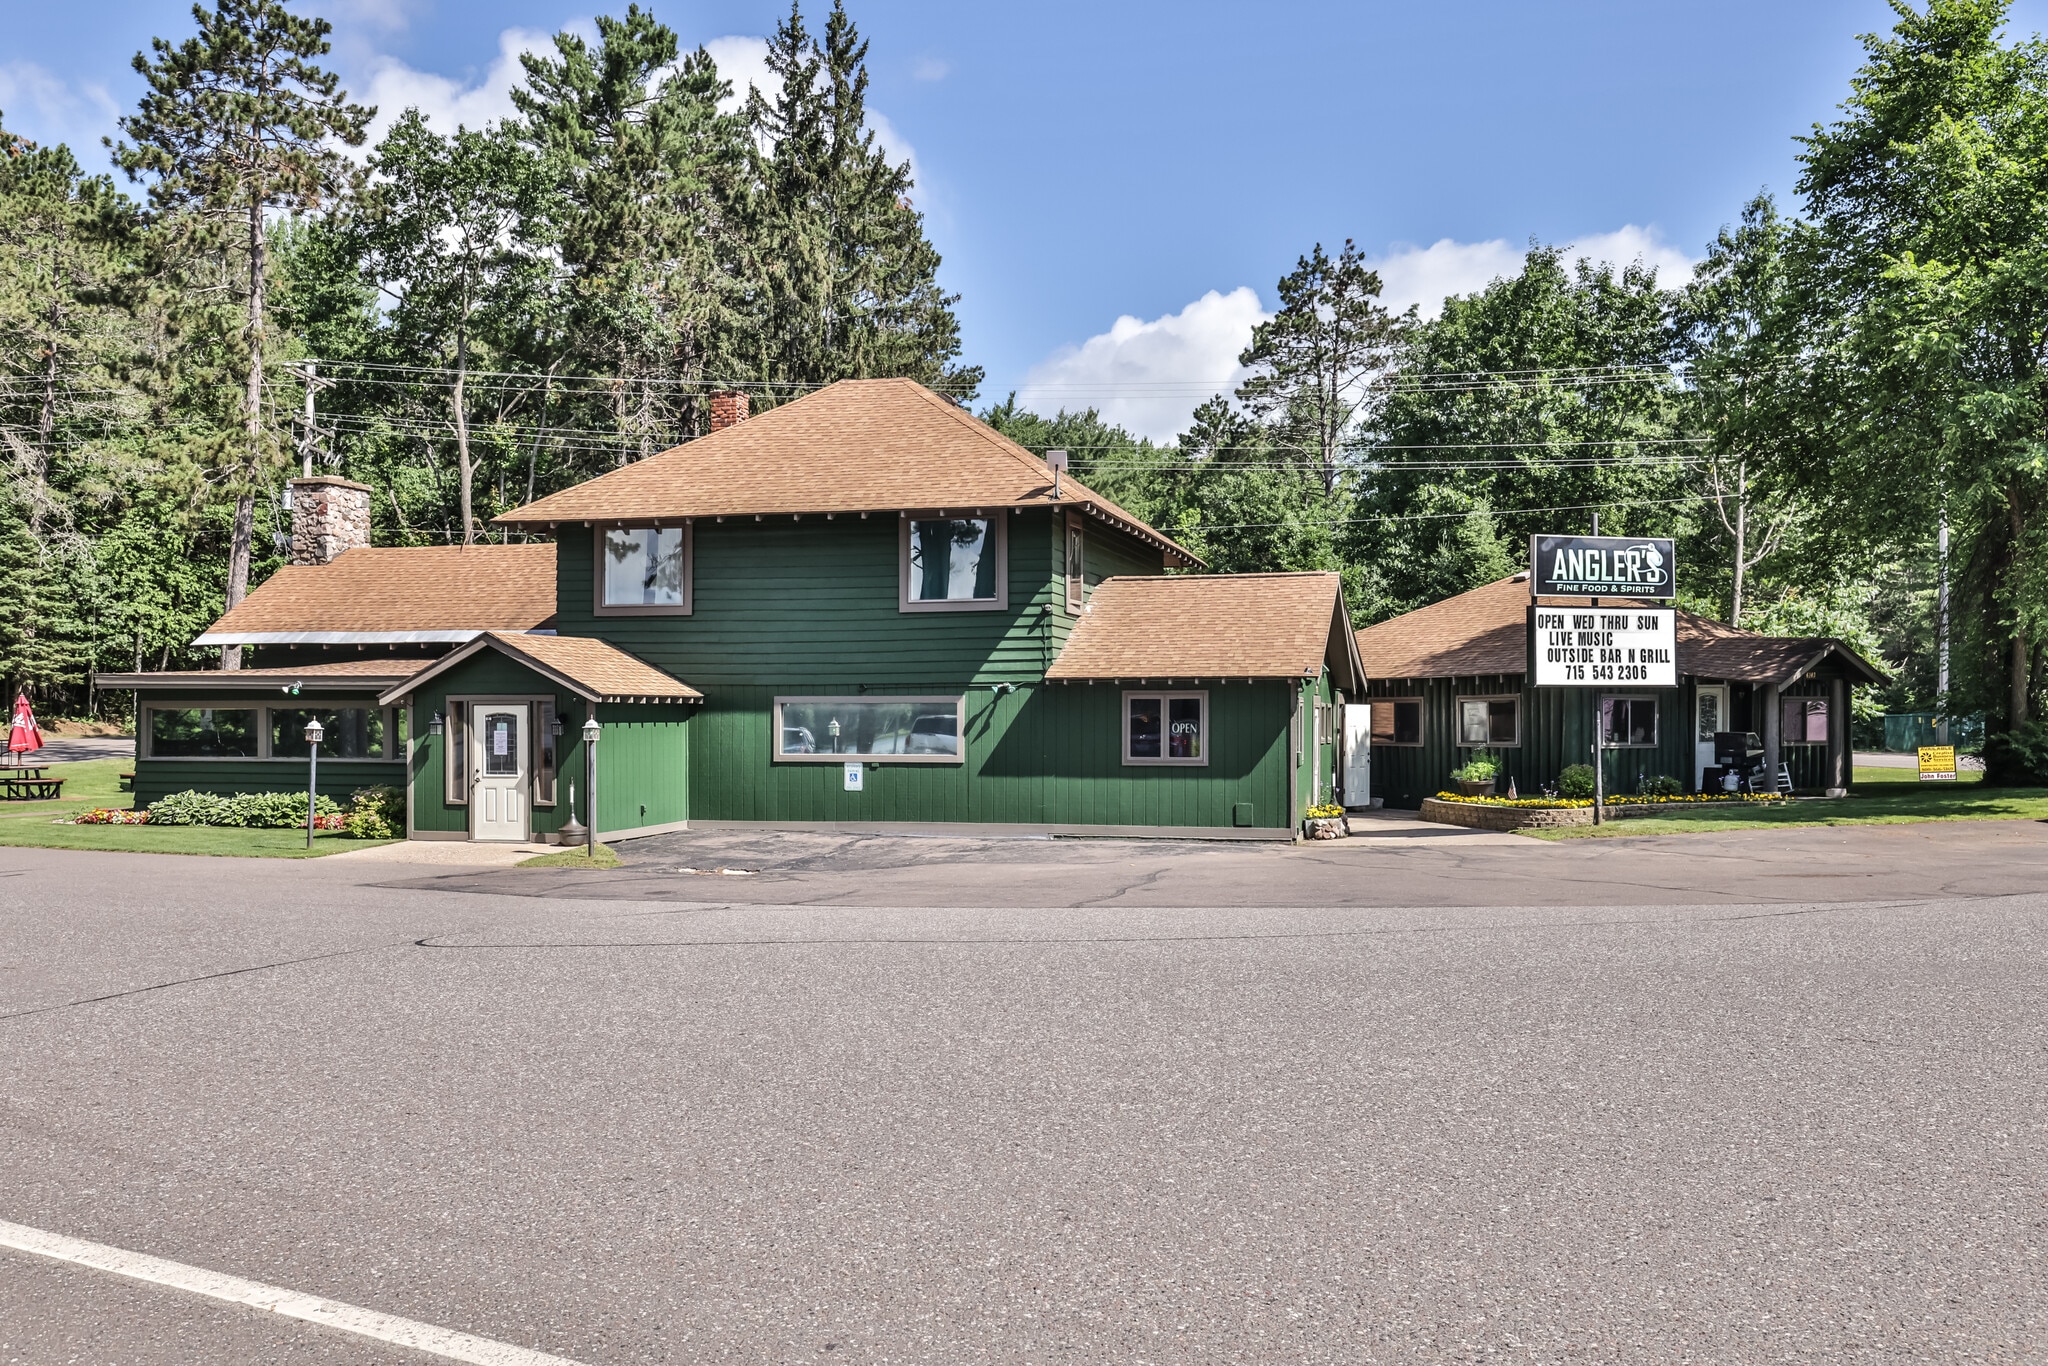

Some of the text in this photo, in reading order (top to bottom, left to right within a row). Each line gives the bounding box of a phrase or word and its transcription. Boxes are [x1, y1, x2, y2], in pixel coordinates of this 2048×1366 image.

[1552, 547, 1661, 582] ANGLER'S
[1556, 583, 1655, 594] FINE FOOD & SPIRITS
[1538, 614, 1659, 630] OPEN WED THRU SUN
[1549, 631, 1613, 647] LIVE MUSIC
[1547, 648, 1670, 663] OUTSIDE BAR N GRILL
[1565, 665, 1648, 680] 715 543 2306
[1171, 722, 1198, 734] OPEN
